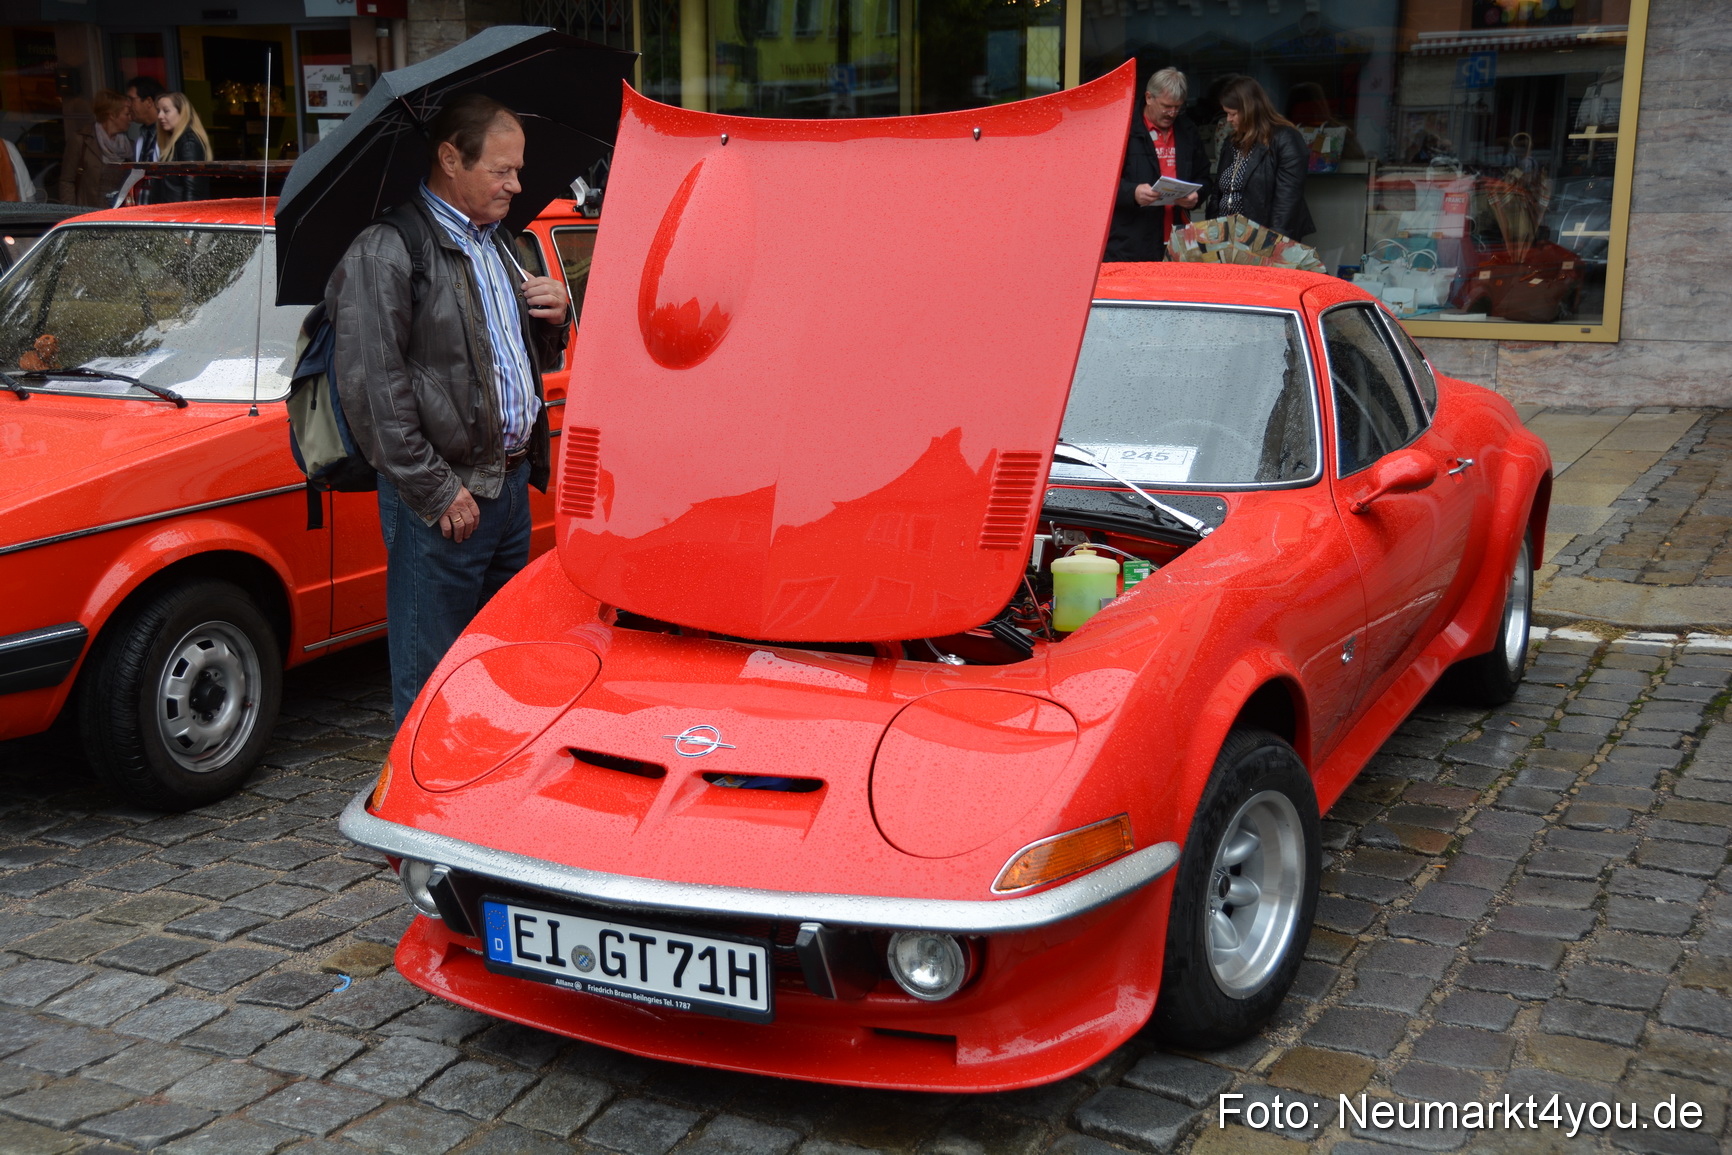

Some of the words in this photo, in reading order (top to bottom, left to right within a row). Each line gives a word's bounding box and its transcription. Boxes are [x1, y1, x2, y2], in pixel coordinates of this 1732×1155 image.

[1120, 450, 1170, 461] 245
[494, 937, 504, 951] D
[514, 913, 566, 967] EI
[599, 928, 656, 982] GT
[667, 939, 758, 1000] 71H
[555, 978, 574, 988] Allianz
[587, 984, 614, 995] Friedrich
[614, 989, 632, 999] Braun
[632, 991, 662, 1005] Beilngries
[663, 998, 674, 1007] Tel.
[675, 1000, 690, 1010] 1787
